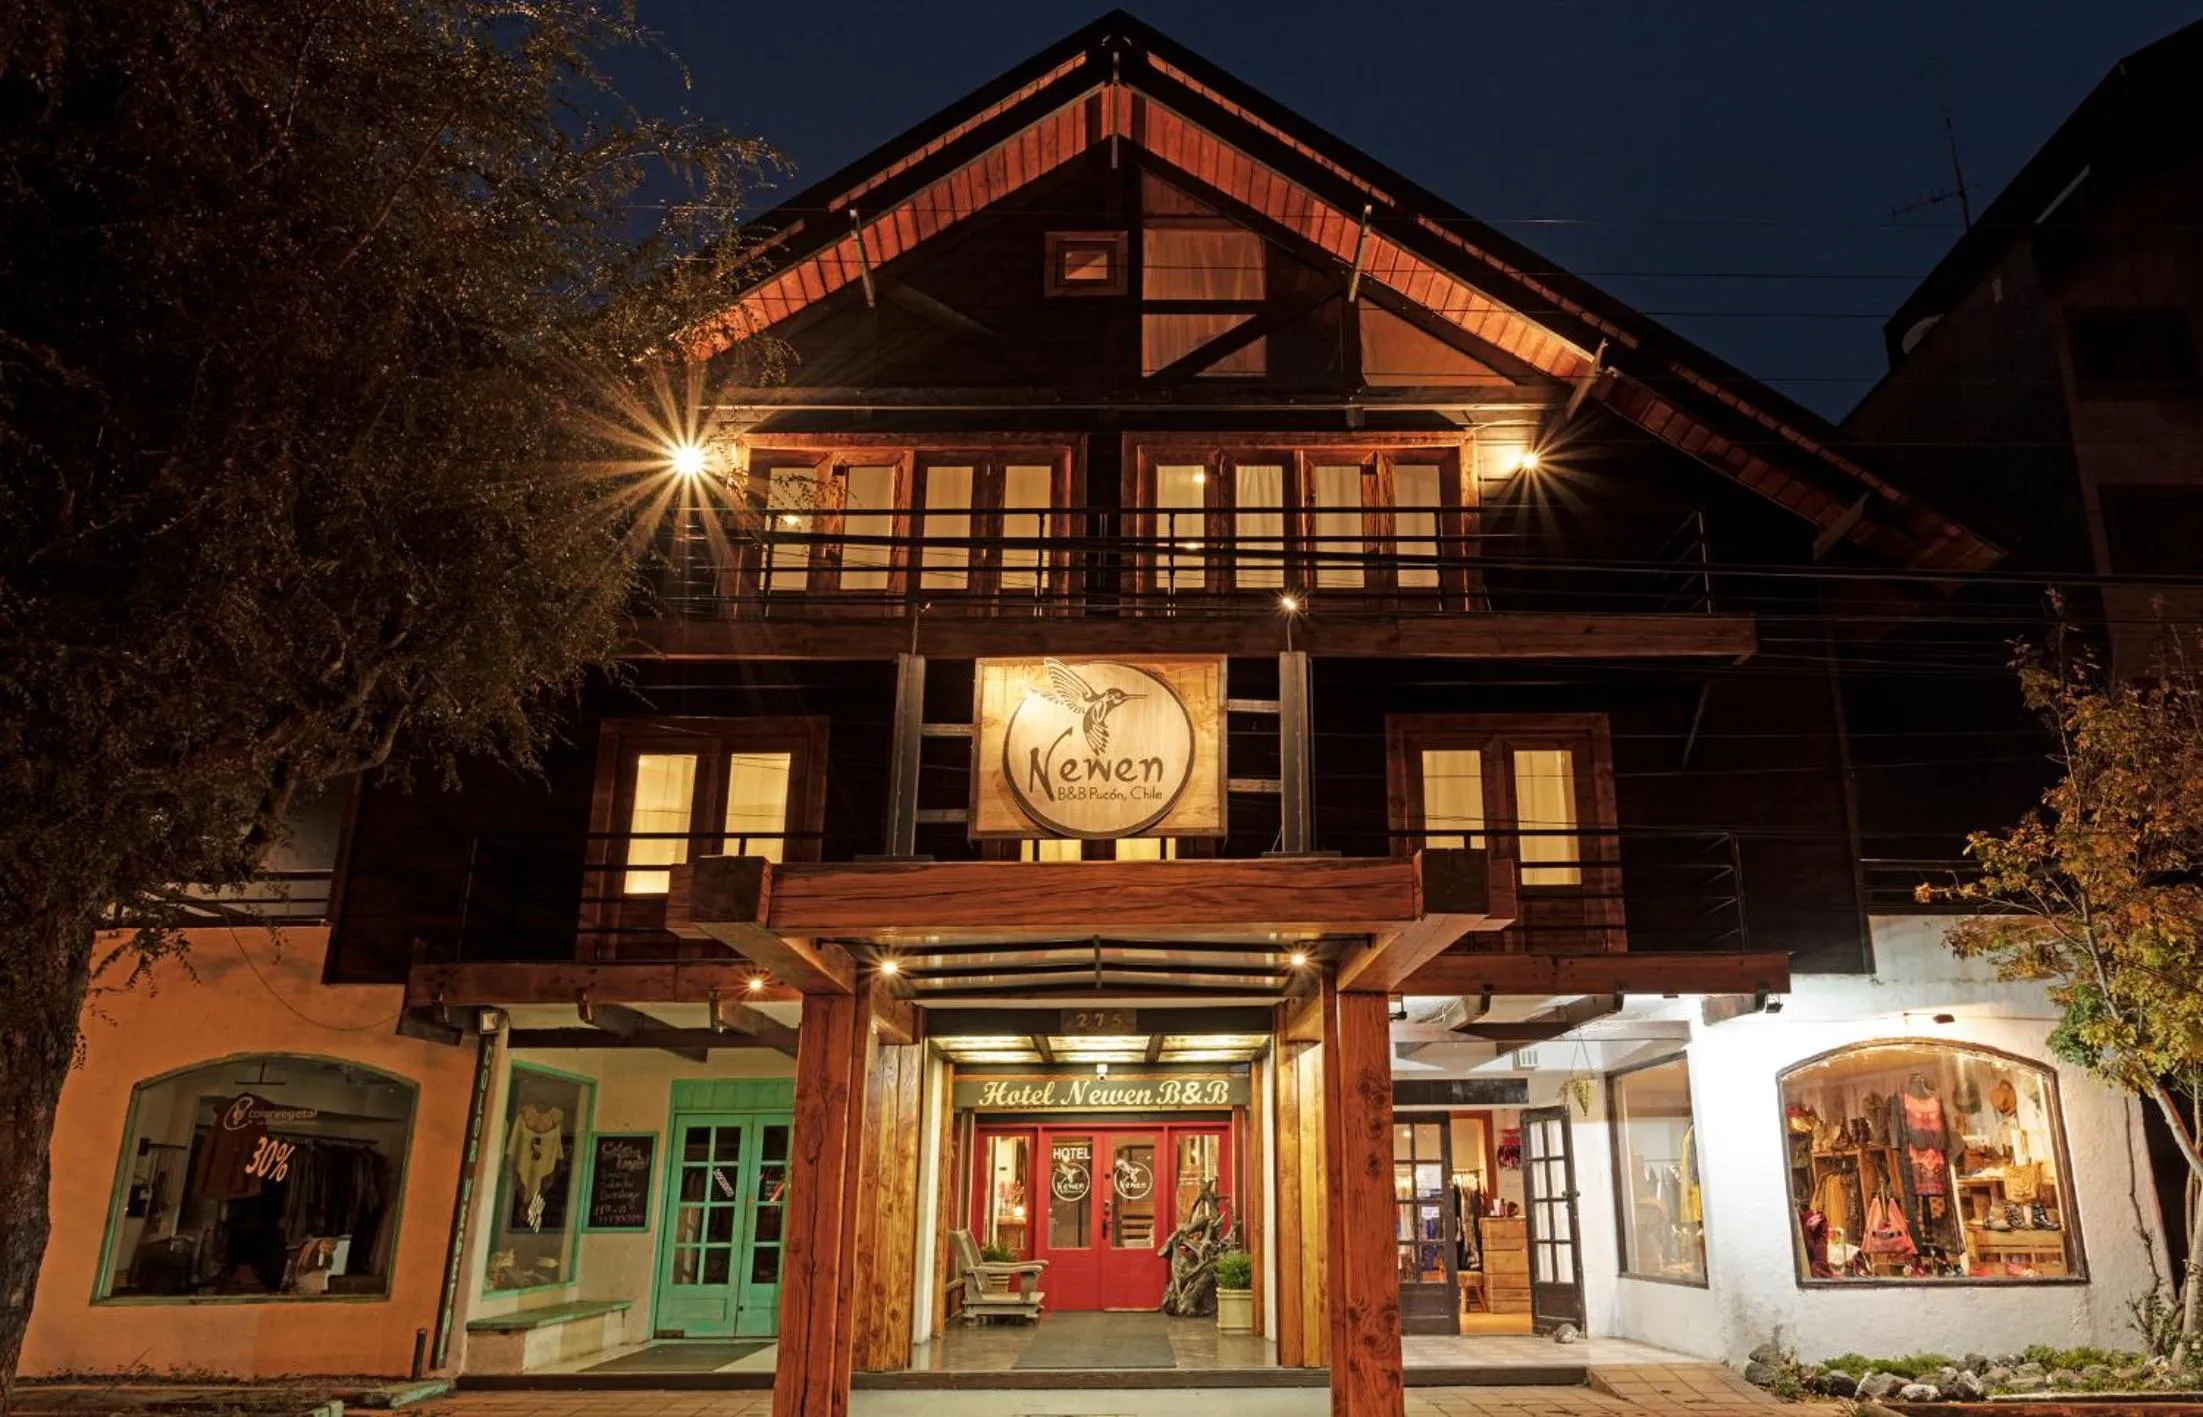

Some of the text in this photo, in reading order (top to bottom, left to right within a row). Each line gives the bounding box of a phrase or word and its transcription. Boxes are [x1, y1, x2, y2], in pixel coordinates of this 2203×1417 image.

[1029, 727, 1164, 802] Newen
[1057, 785, 1162, 802] B&B Pucón, Chile
[979, 1080, 1229, 1106] Hotel Newen B&B
[244, 1136, 297, 1183] 30%
[1053, 1147, 1092, 1160] HOTEL
